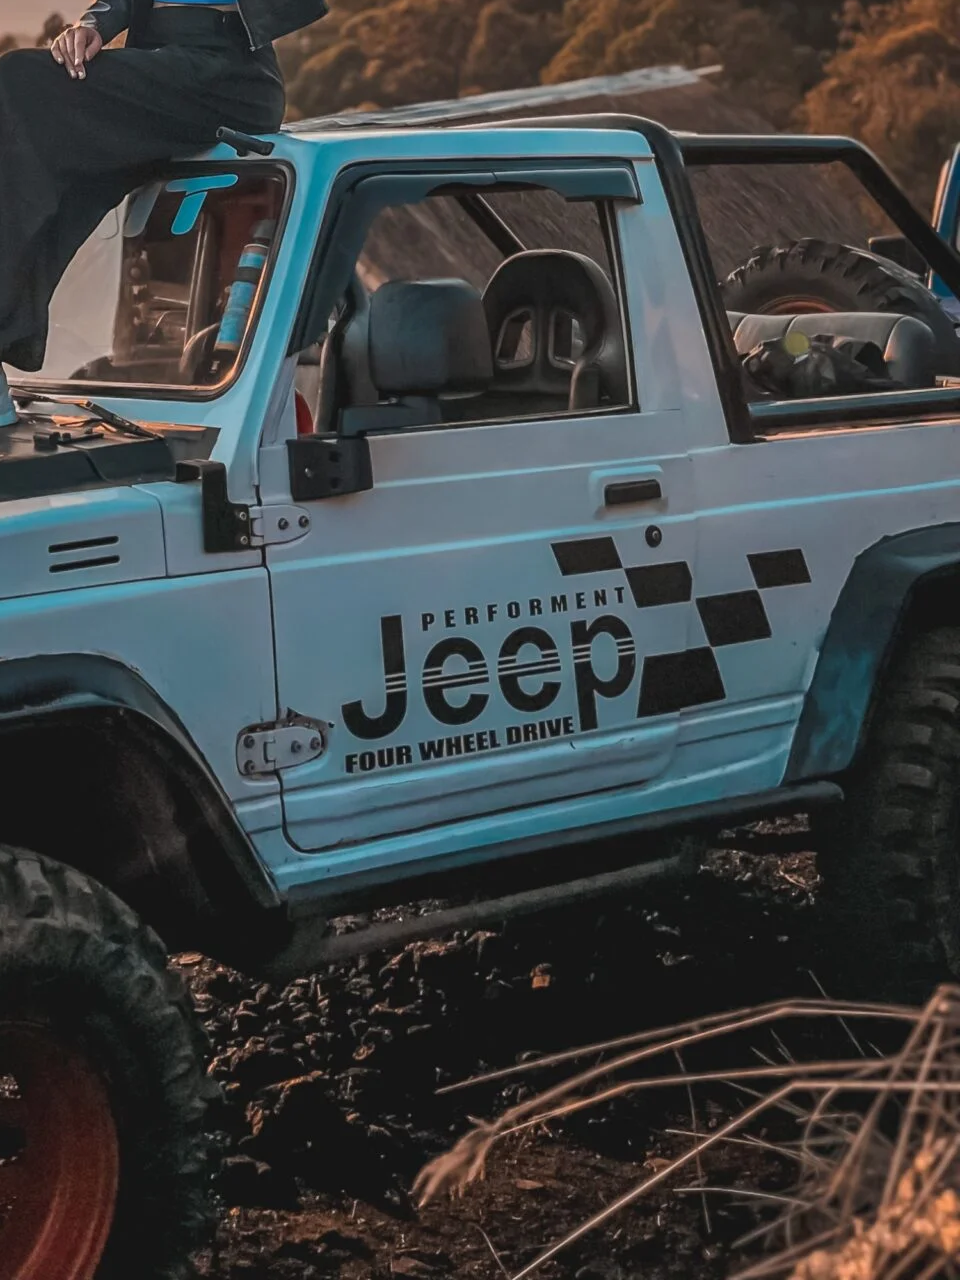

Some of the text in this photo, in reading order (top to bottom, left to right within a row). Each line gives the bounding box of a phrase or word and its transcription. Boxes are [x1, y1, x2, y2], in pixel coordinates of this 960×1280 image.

[421, 586, 625, 631] PERFORMENT
[341, 614, 636, 740] Jeep
[345, 716, 575, 773] FOUR WHEEL DRIVE
